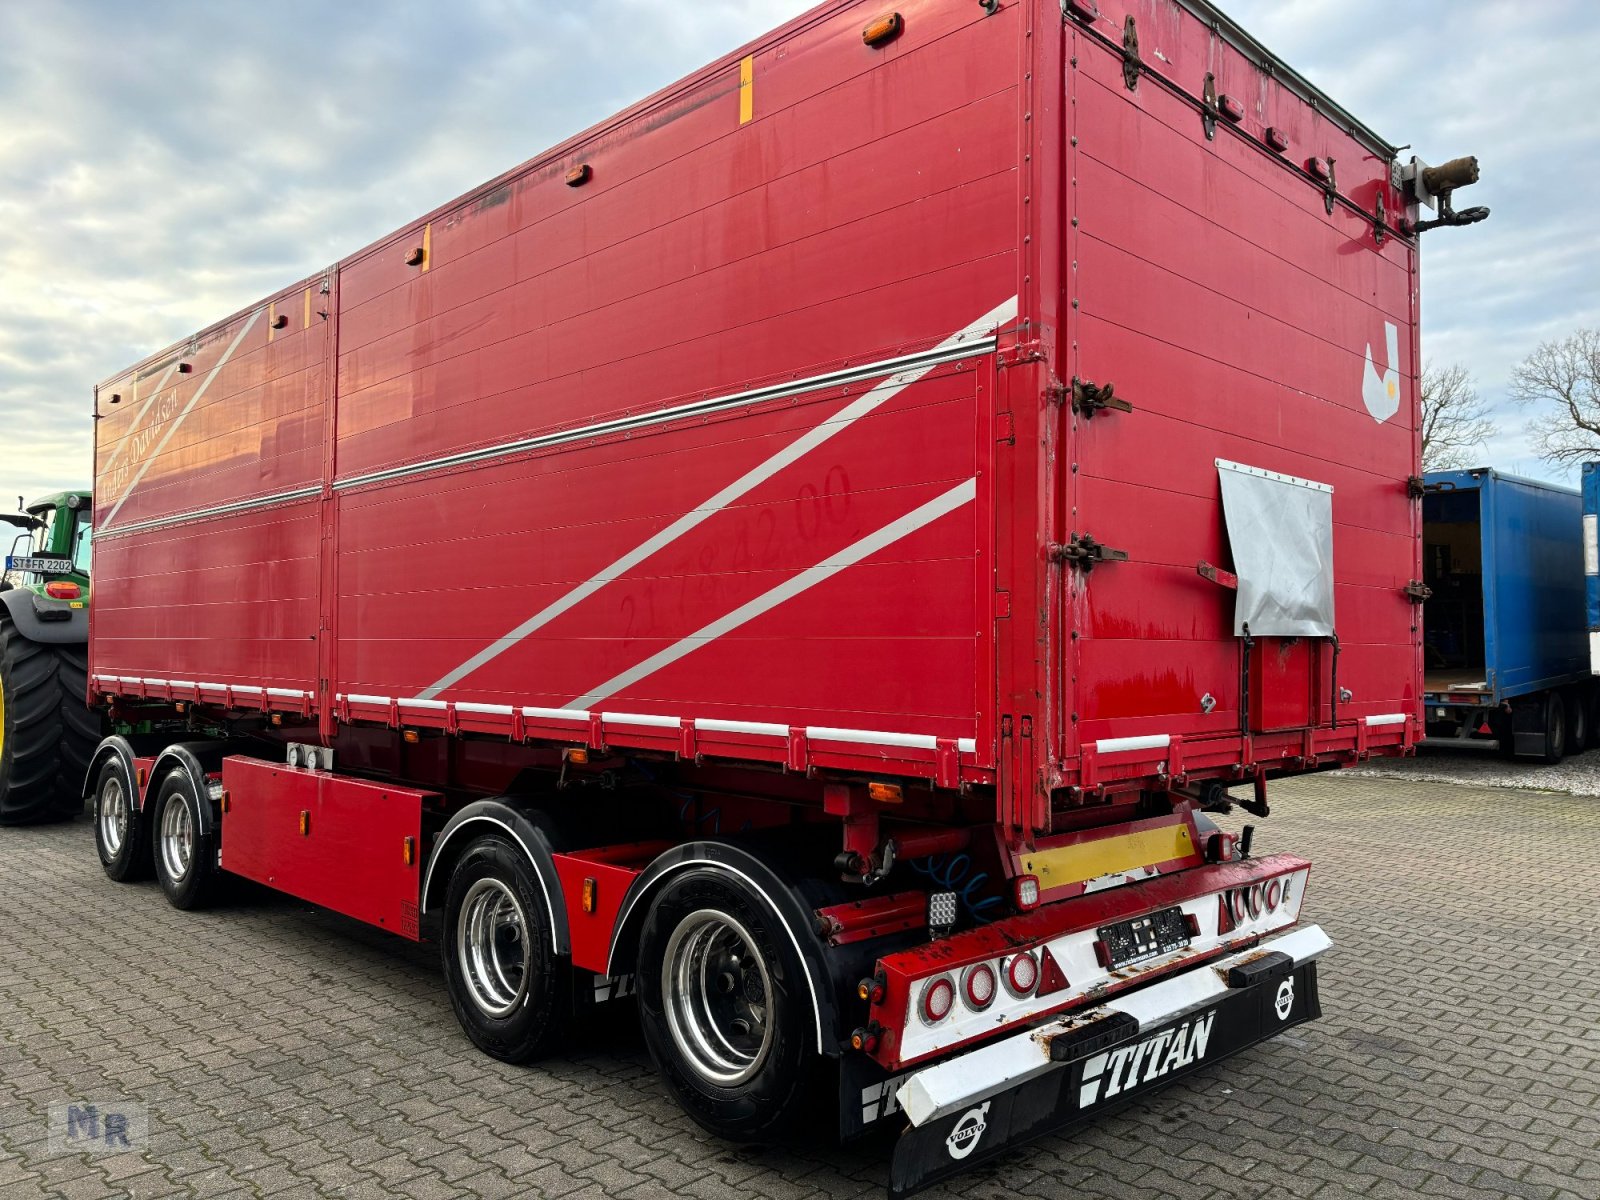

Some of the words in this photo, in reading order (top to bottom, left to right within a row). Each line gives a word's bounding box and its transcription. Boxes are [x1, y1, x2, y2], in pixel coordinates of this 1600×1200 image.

[131, 388, 179, 464] Davidsen
[13, 558, 26, 568] ST
[32, 559, 45, 570] FR
[47, 560, 71, 571] 2202
[1105, 1009, 1217, 1099] TITAN
[950, 1124, 985, 1142] VOLVO
